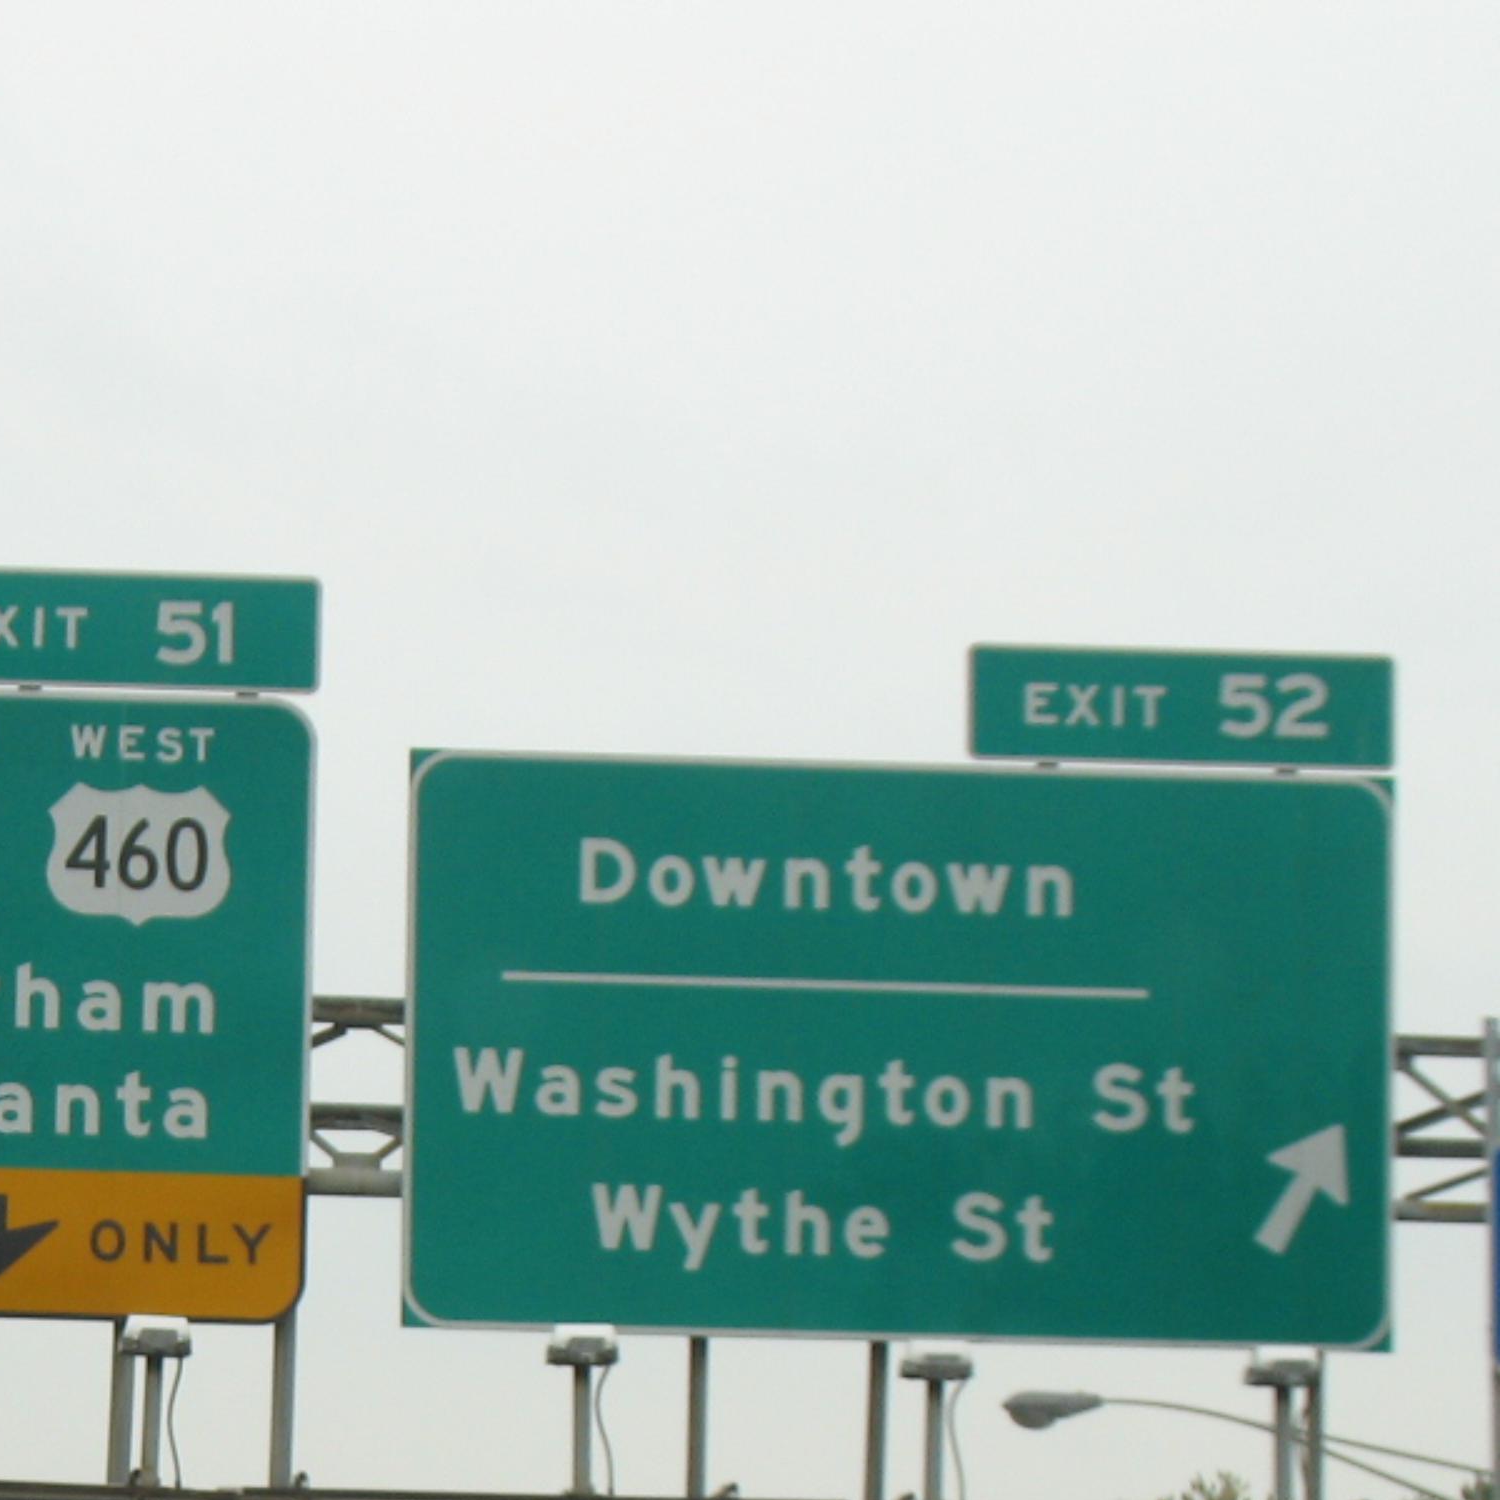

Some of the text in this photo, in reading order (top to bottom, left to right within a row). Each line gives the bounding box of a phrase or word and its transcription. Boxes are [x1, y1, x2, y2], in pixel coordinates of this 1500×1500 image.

[156, 600, 235, 666] 51
[1024, 672, 1329, 738] EXIT 52
[71, 724, 216, 763] WEST
[65, 815, 209, 892] 460
[579, 837, 1074, 917] Downtown
[453, 1046, 1195, 1147] Washington St
[90, 1219, 272, 1265] ONLY
[592, 1182, 1055, 1271] Wythe St
